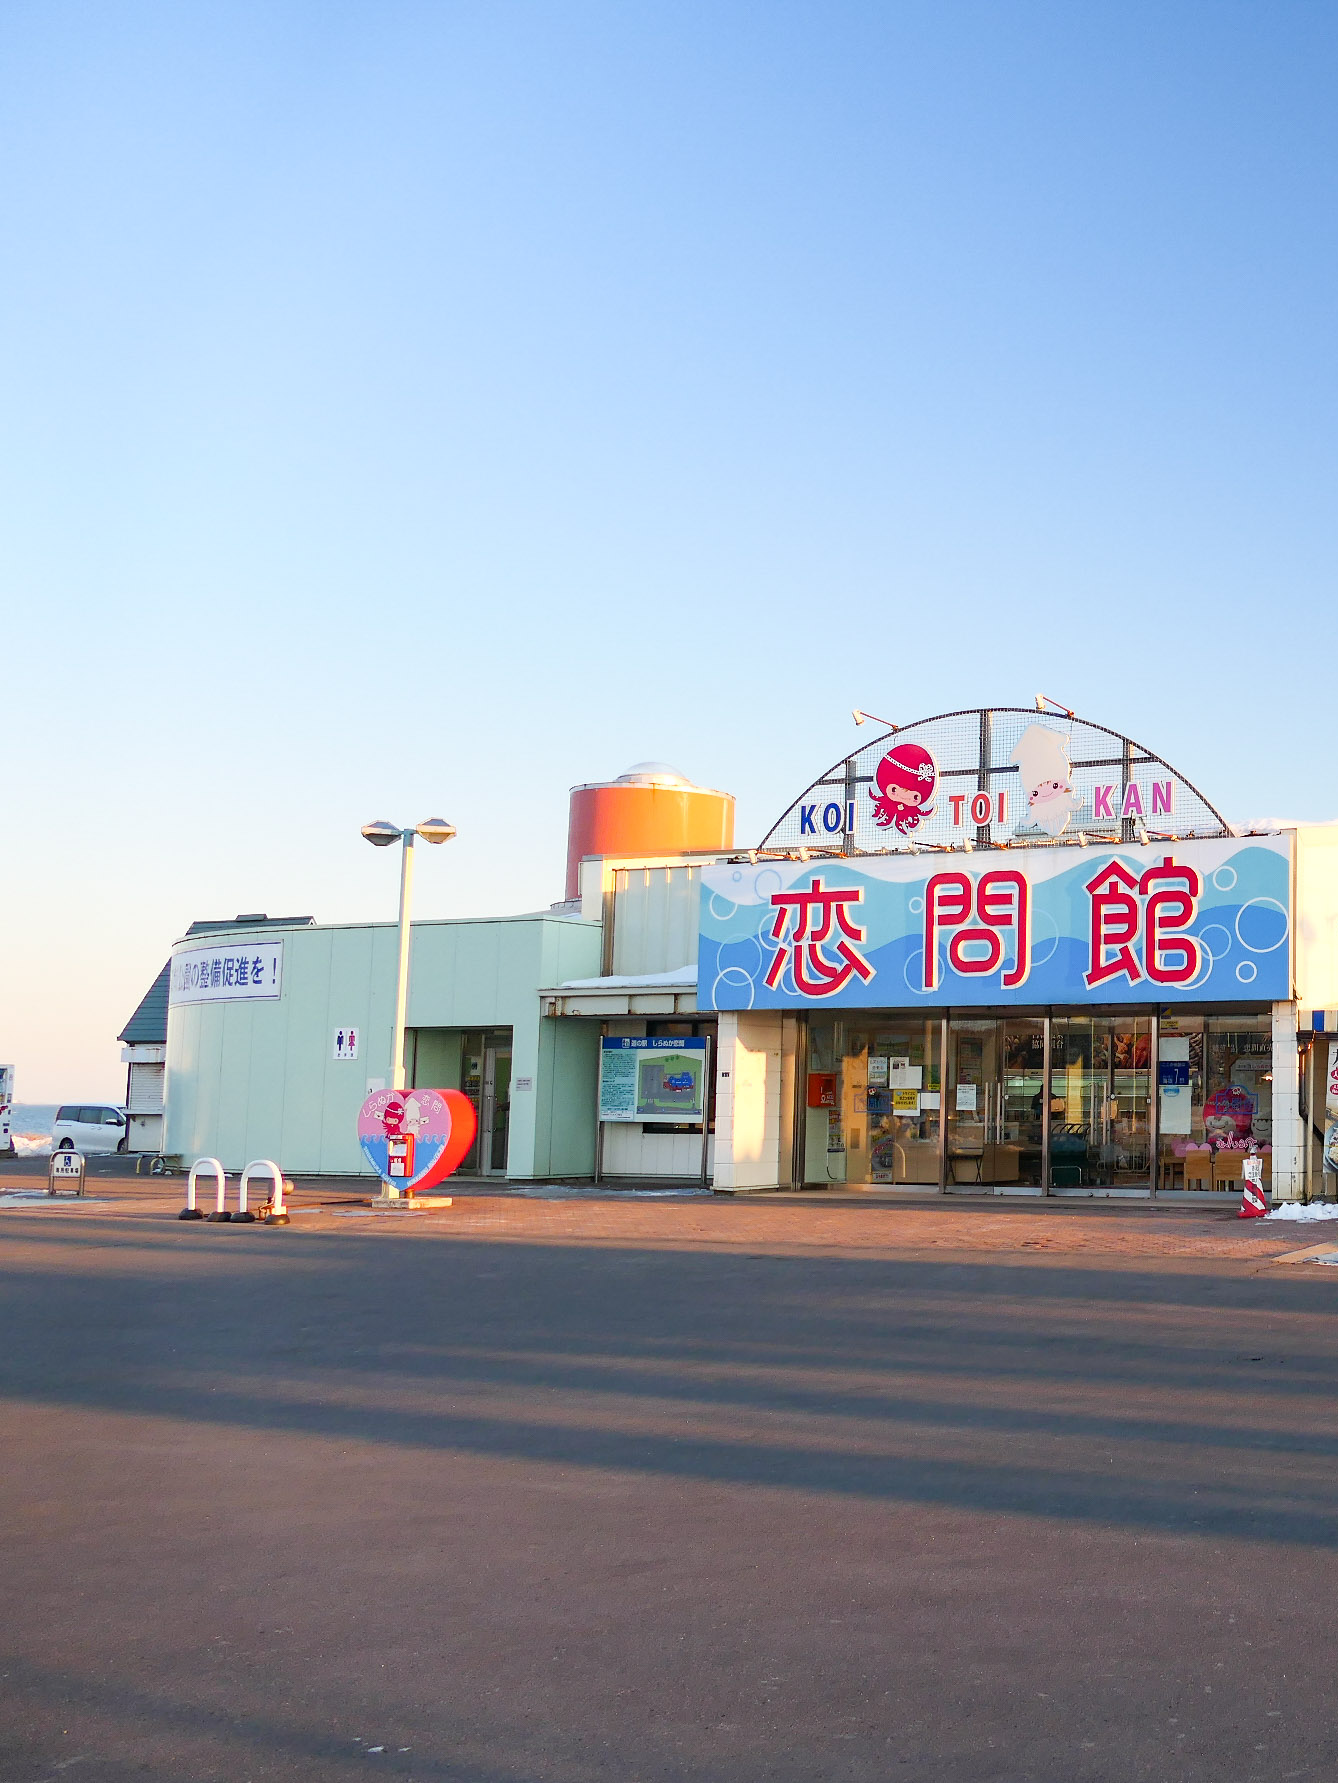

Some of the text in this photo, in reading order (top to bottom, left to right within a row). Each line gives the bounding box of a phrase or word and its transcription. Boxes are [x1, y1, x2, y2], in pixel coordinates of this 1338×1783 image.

[800, 780, 1175, 835] KOI TOI KAN
[764, 856, 1203, 998] 恋問館
[362, 1092, 396, 1118] しらぬか
